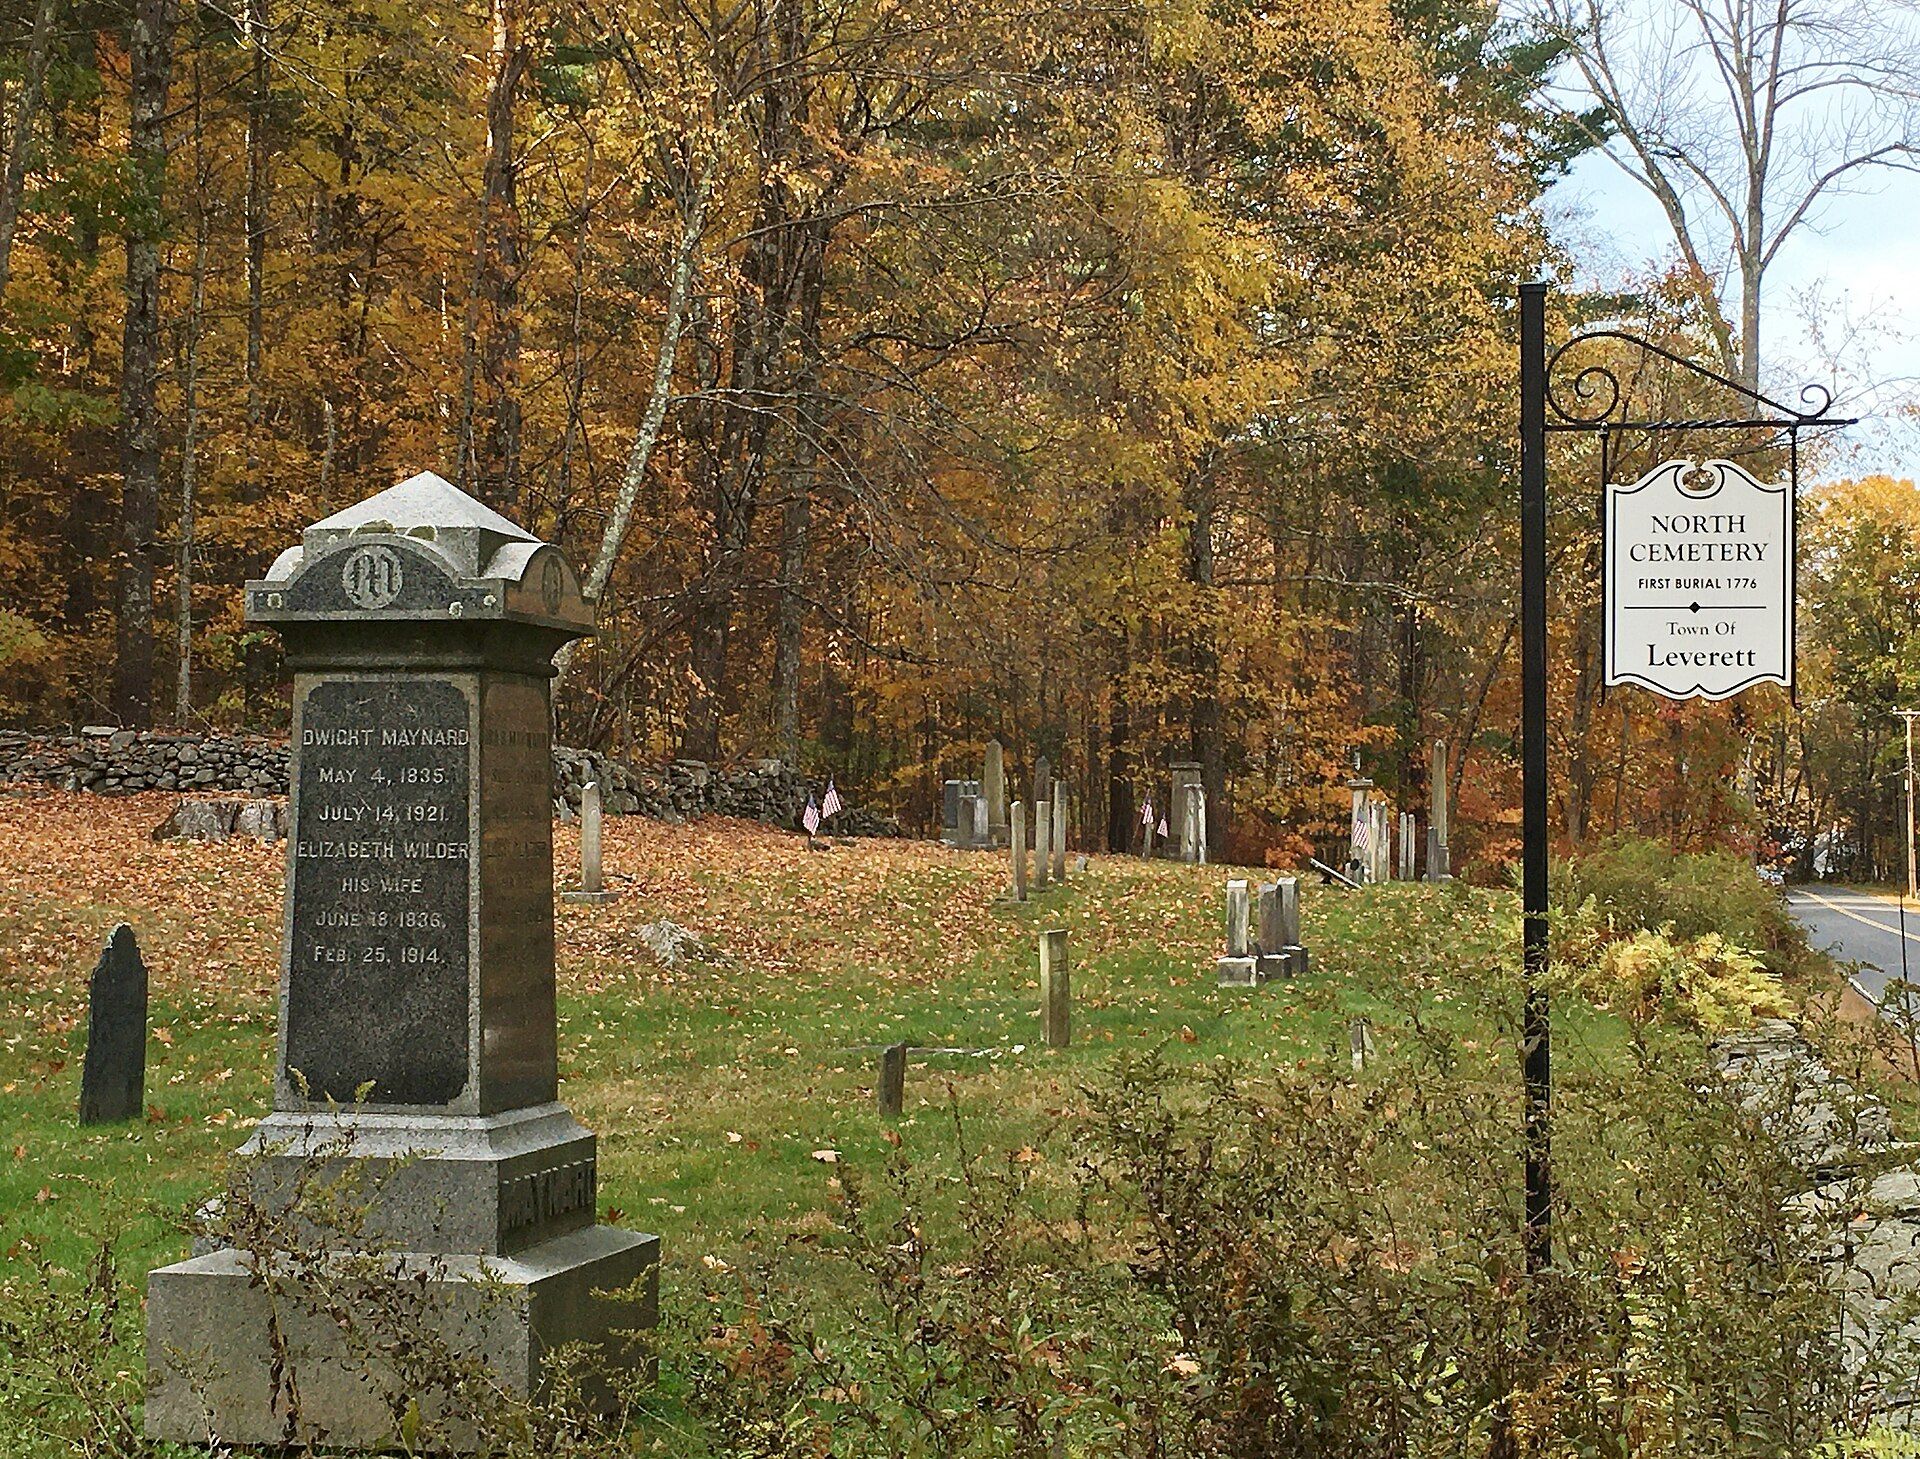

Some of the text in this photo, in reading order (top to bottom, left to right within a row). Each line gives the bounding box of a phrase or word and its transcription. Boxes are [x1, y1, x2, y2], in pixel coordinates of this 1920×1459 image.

[1651, 515, 1746, 534] NORTH
[1629, 543, 1769, 562] CEMETERY
[1638, 578, 1758, 590] FIRST BURIAL 1776
[1666, 620, 1737, 636] Town Of
[1647, 644, 1757, 667] Leverett
[302, 728, 374, 747] DWIGHT
[381, 728, 469, 747] MAYNARD
[318, 767, 357, 783] MAY
[318, 804, 365, 822] JULY
[297, 841, 394, 859] ELIZABETH
[404, 841, 469, 859] WILDER
[341, 877, 424, 894] HIS WIFE
[315, 911, 361, 927] JUNE
